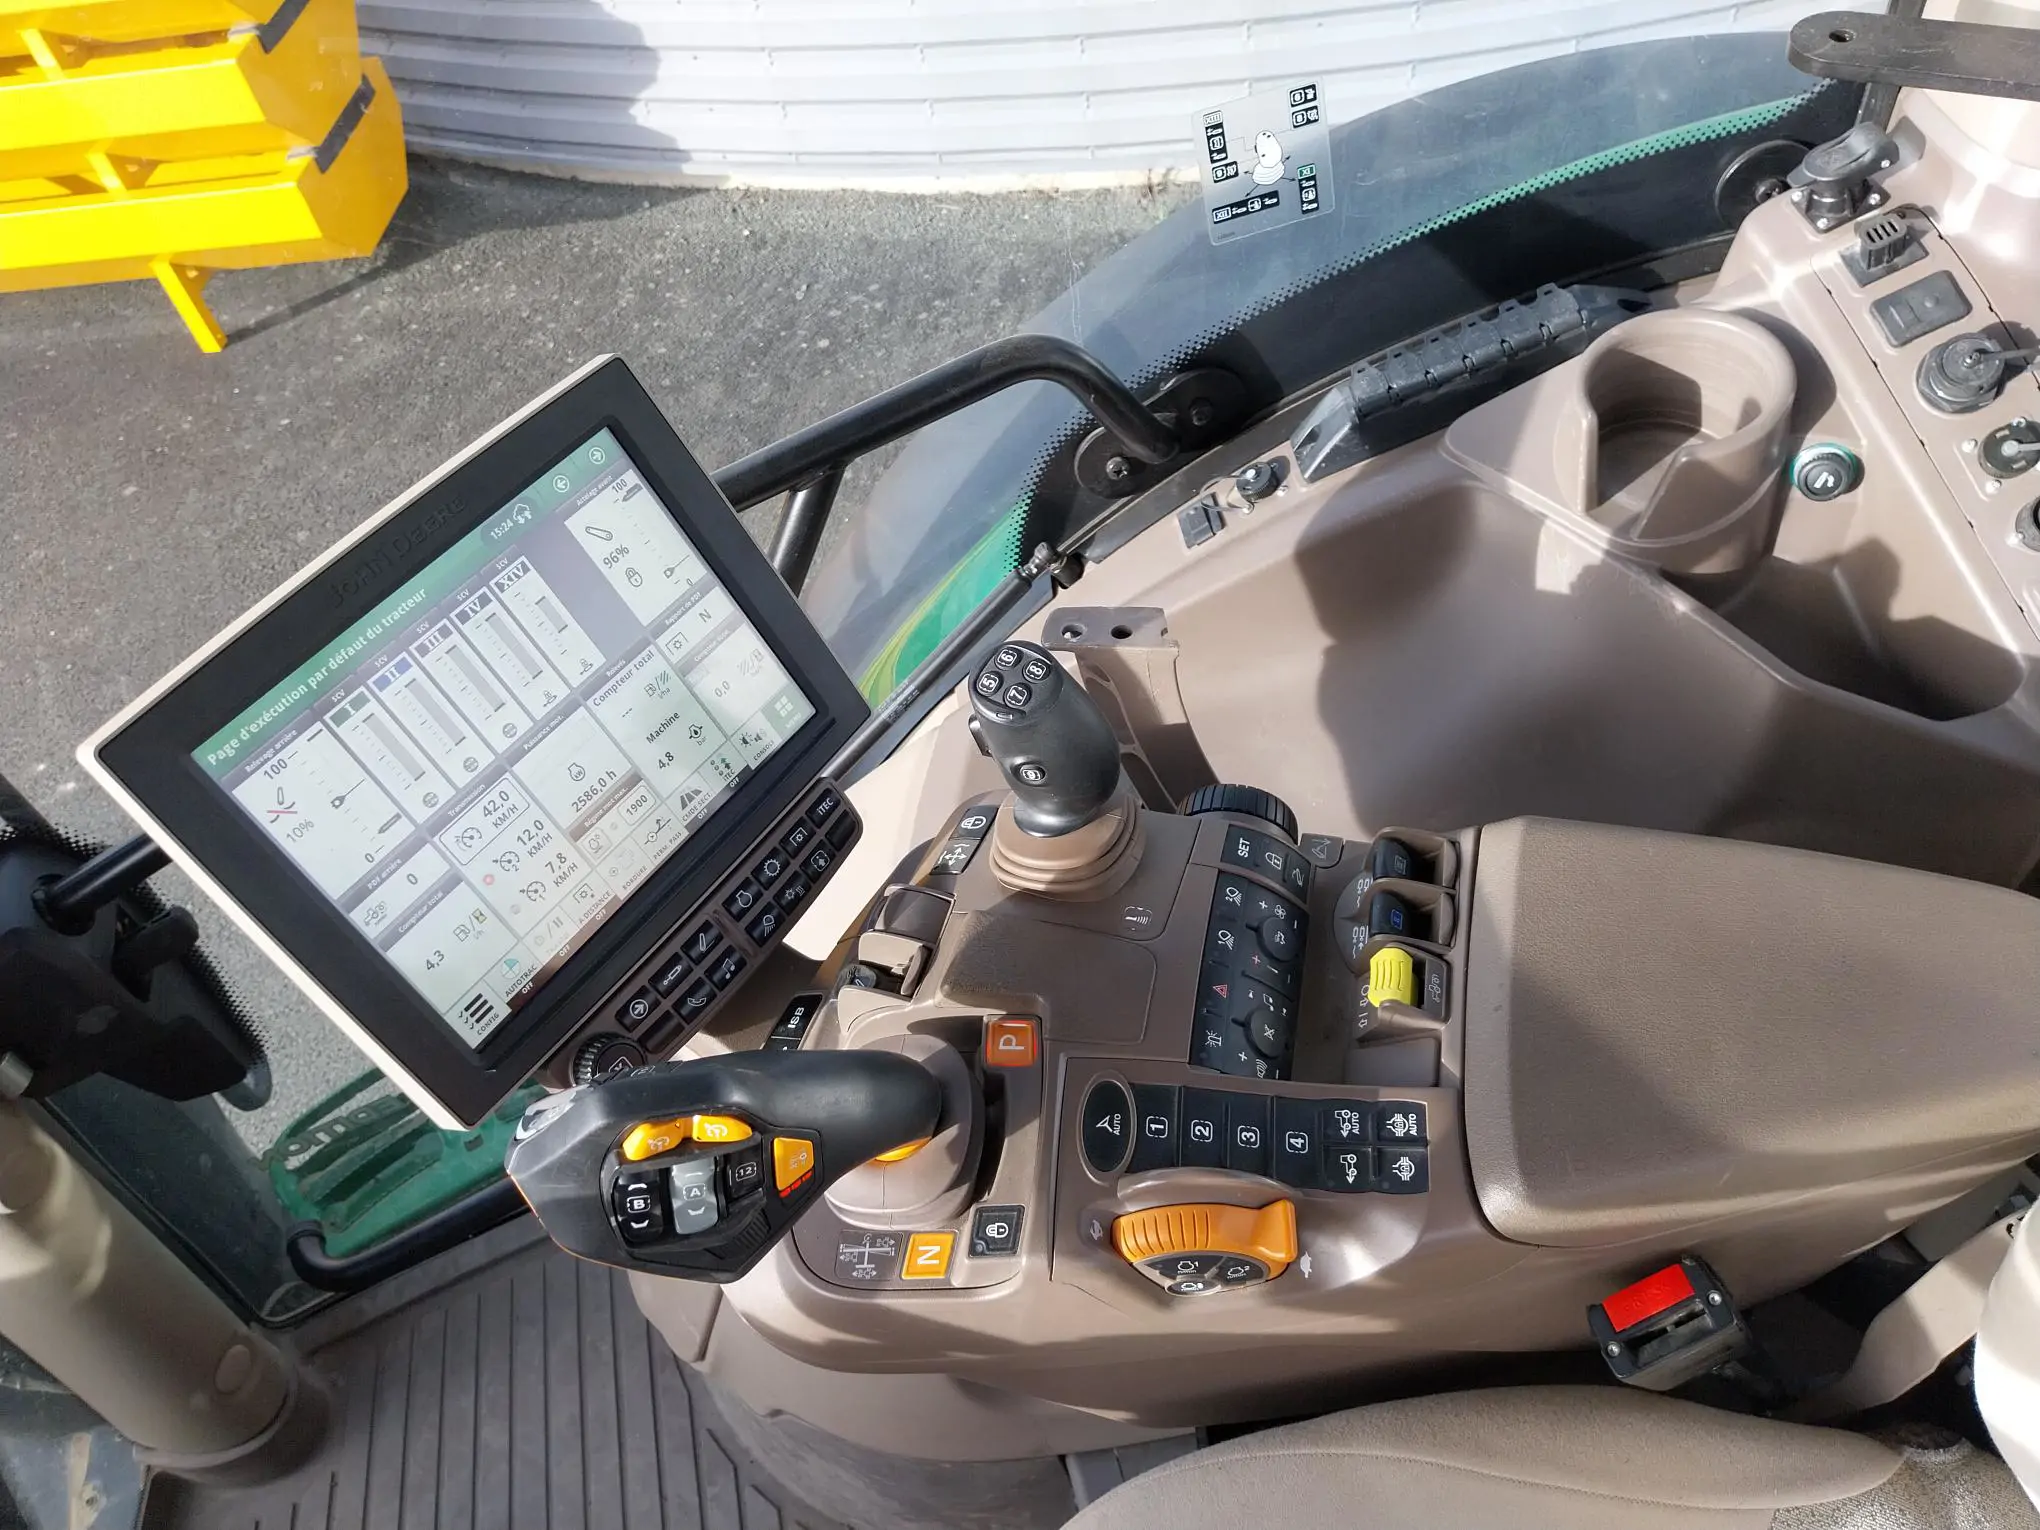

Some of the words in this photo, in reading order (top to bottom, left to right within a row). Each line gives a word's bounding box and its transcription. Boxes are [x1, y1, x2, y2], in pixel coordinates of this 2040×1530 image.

[575, 485, 599, 507] Attelage
[596, 474, 613, 489] avant
[611, 477, 628, 494] 100
[489, 518, 514, 540] 15:24
[331, 546, 395, 609] JOHN
[393, 496, 467, 560] DEERE
[601, 542, 630, 569] 96%
[495, 556, 509, 570] SCV
[497, 562, 527, 590] XIV
[685, 577, 694, 587] 0
[456, 588, 470, 601] SCV
[463, 597, 484, 617] IV
[698, 608, 712, 623] N
[415, 620, 431, 634] SCV
[423, 630, 445, 650] III
[373, 653, 390, 668] SCV
[1002, 653, 1014, 662] 6
[206, 736, 243, 768] Page
[236, 682, 309, 742] d'exécution
[306, 665, 333, 690] par
[326, 634, 368, 670] défaut
[364, 622, 384, 640] du
[381, 587, 429, 628] tracteur
[383, 665, 401, 682] II
[591, 667, 636, 708] Compteur
[632, 649, 654, 671] total
[1030, 666, 1042, 675] 8
[713, 679, 732, 699] 0,0
[983, 677, 995, 688] 5
[330, 688, 347, 703] SCV
[1010, 689, 1023, 701] 7
[343, 702, 356, 715] I
[522, 723, 551, 750] Puissance
[645, 710, 680, 744] Machine
[695, 733, 707, 746] bar
[752, 738, 775, 761] CONSOLE
[243, 744, 278, 774] Relevage
[272, 727, 298, 749] arrière
[655, 750, 676, 771] 4,8
[261, 757, 289, 781] 100
[572, 767, 584, 780] kW
[721, 767, 736, 782] iTEC
[570, 775, 609, 813] 2586,0
[605, 767, 617, 780] h
[728, 775, 741, 789] OFF
[447, 782, 486, 818] Transmission
[479, 788, 512, 820] 42,0
[624, 792, 649, 817] 1900
[817, 797, 834, 816] iTEC
[491, 802, 519, 829] KM/H
[680, 803, 699, 823] CMDE
[696, 806, 709, 820] OFF
[284, 816, 316, 845] 10%
[515, 818, 546, 848] 12,0
[526, 832, 553, 858] KM/H
[1237, 837, 1250, 858] SET
[363, 851, 376, 864] 0
[544, 851, 569, 875] 7,8
[404, 871, 419, 886] 0
[552, 861, 578, 887] KM/H
[621, 864, 648, 891] BORDURE
[397, 903, 430, 934] Compteur
[427, 890, 444, 906] total
[583, 890, 612, 919] DISTANCE
[594, 907, 608, 921] OFF
[422, 948, 447, 972] 4,3
[558, 944, 571, 957] OFF
[503, 963, 538, 997] AUTOTRAC
[520, 980, 534, 994] OFF
[475, 1011, 500, 1036] CONFIG
[788, 1007, 804, 1028] ISB
[998, 1034, 1024, 1050] P
[1113, 1114, 1121, 1135] AUTO
[1151, 1122, 1164, 1131] 1
[1195, 1127, 1209, 1136] 2
[1351, 1112, 1360, 1135] AUTO
[1408, 1113, 1418, 1136] AUTO
[1241, 1131, 1256, 1142] 3
[1289, 1137, 1304, 1149] 4
[740, 1166, 752, 1176] 12
[690, 1188, 701, 1197] A
[633, 1199, 645, 1209] B
[917, 1245, 941, 1265] N
